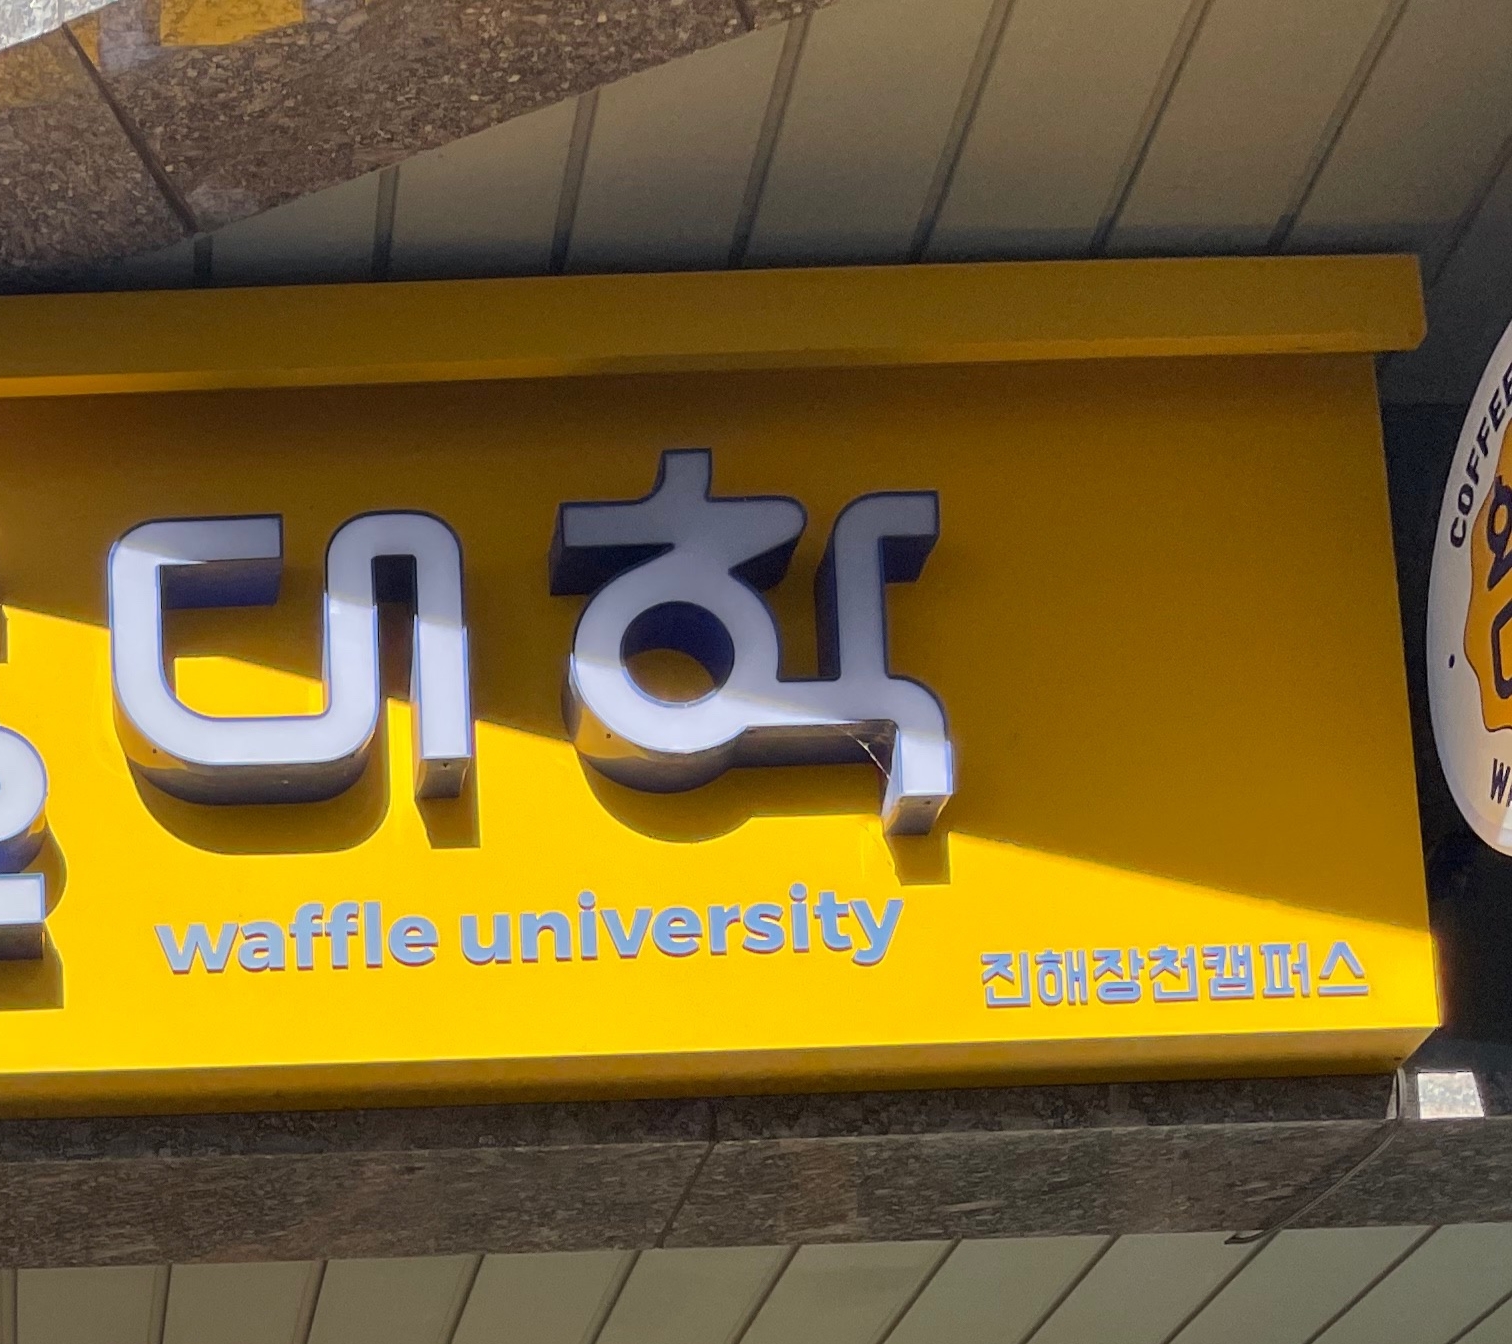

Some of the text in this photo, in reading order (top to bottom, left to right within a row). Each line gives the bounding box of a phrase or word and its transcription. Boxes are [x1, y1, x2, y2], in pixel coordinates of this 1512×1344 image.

[155, 883, 904, 975] waffle university
[980, 941, 1369, 1008] 진해장천캠퍼스
